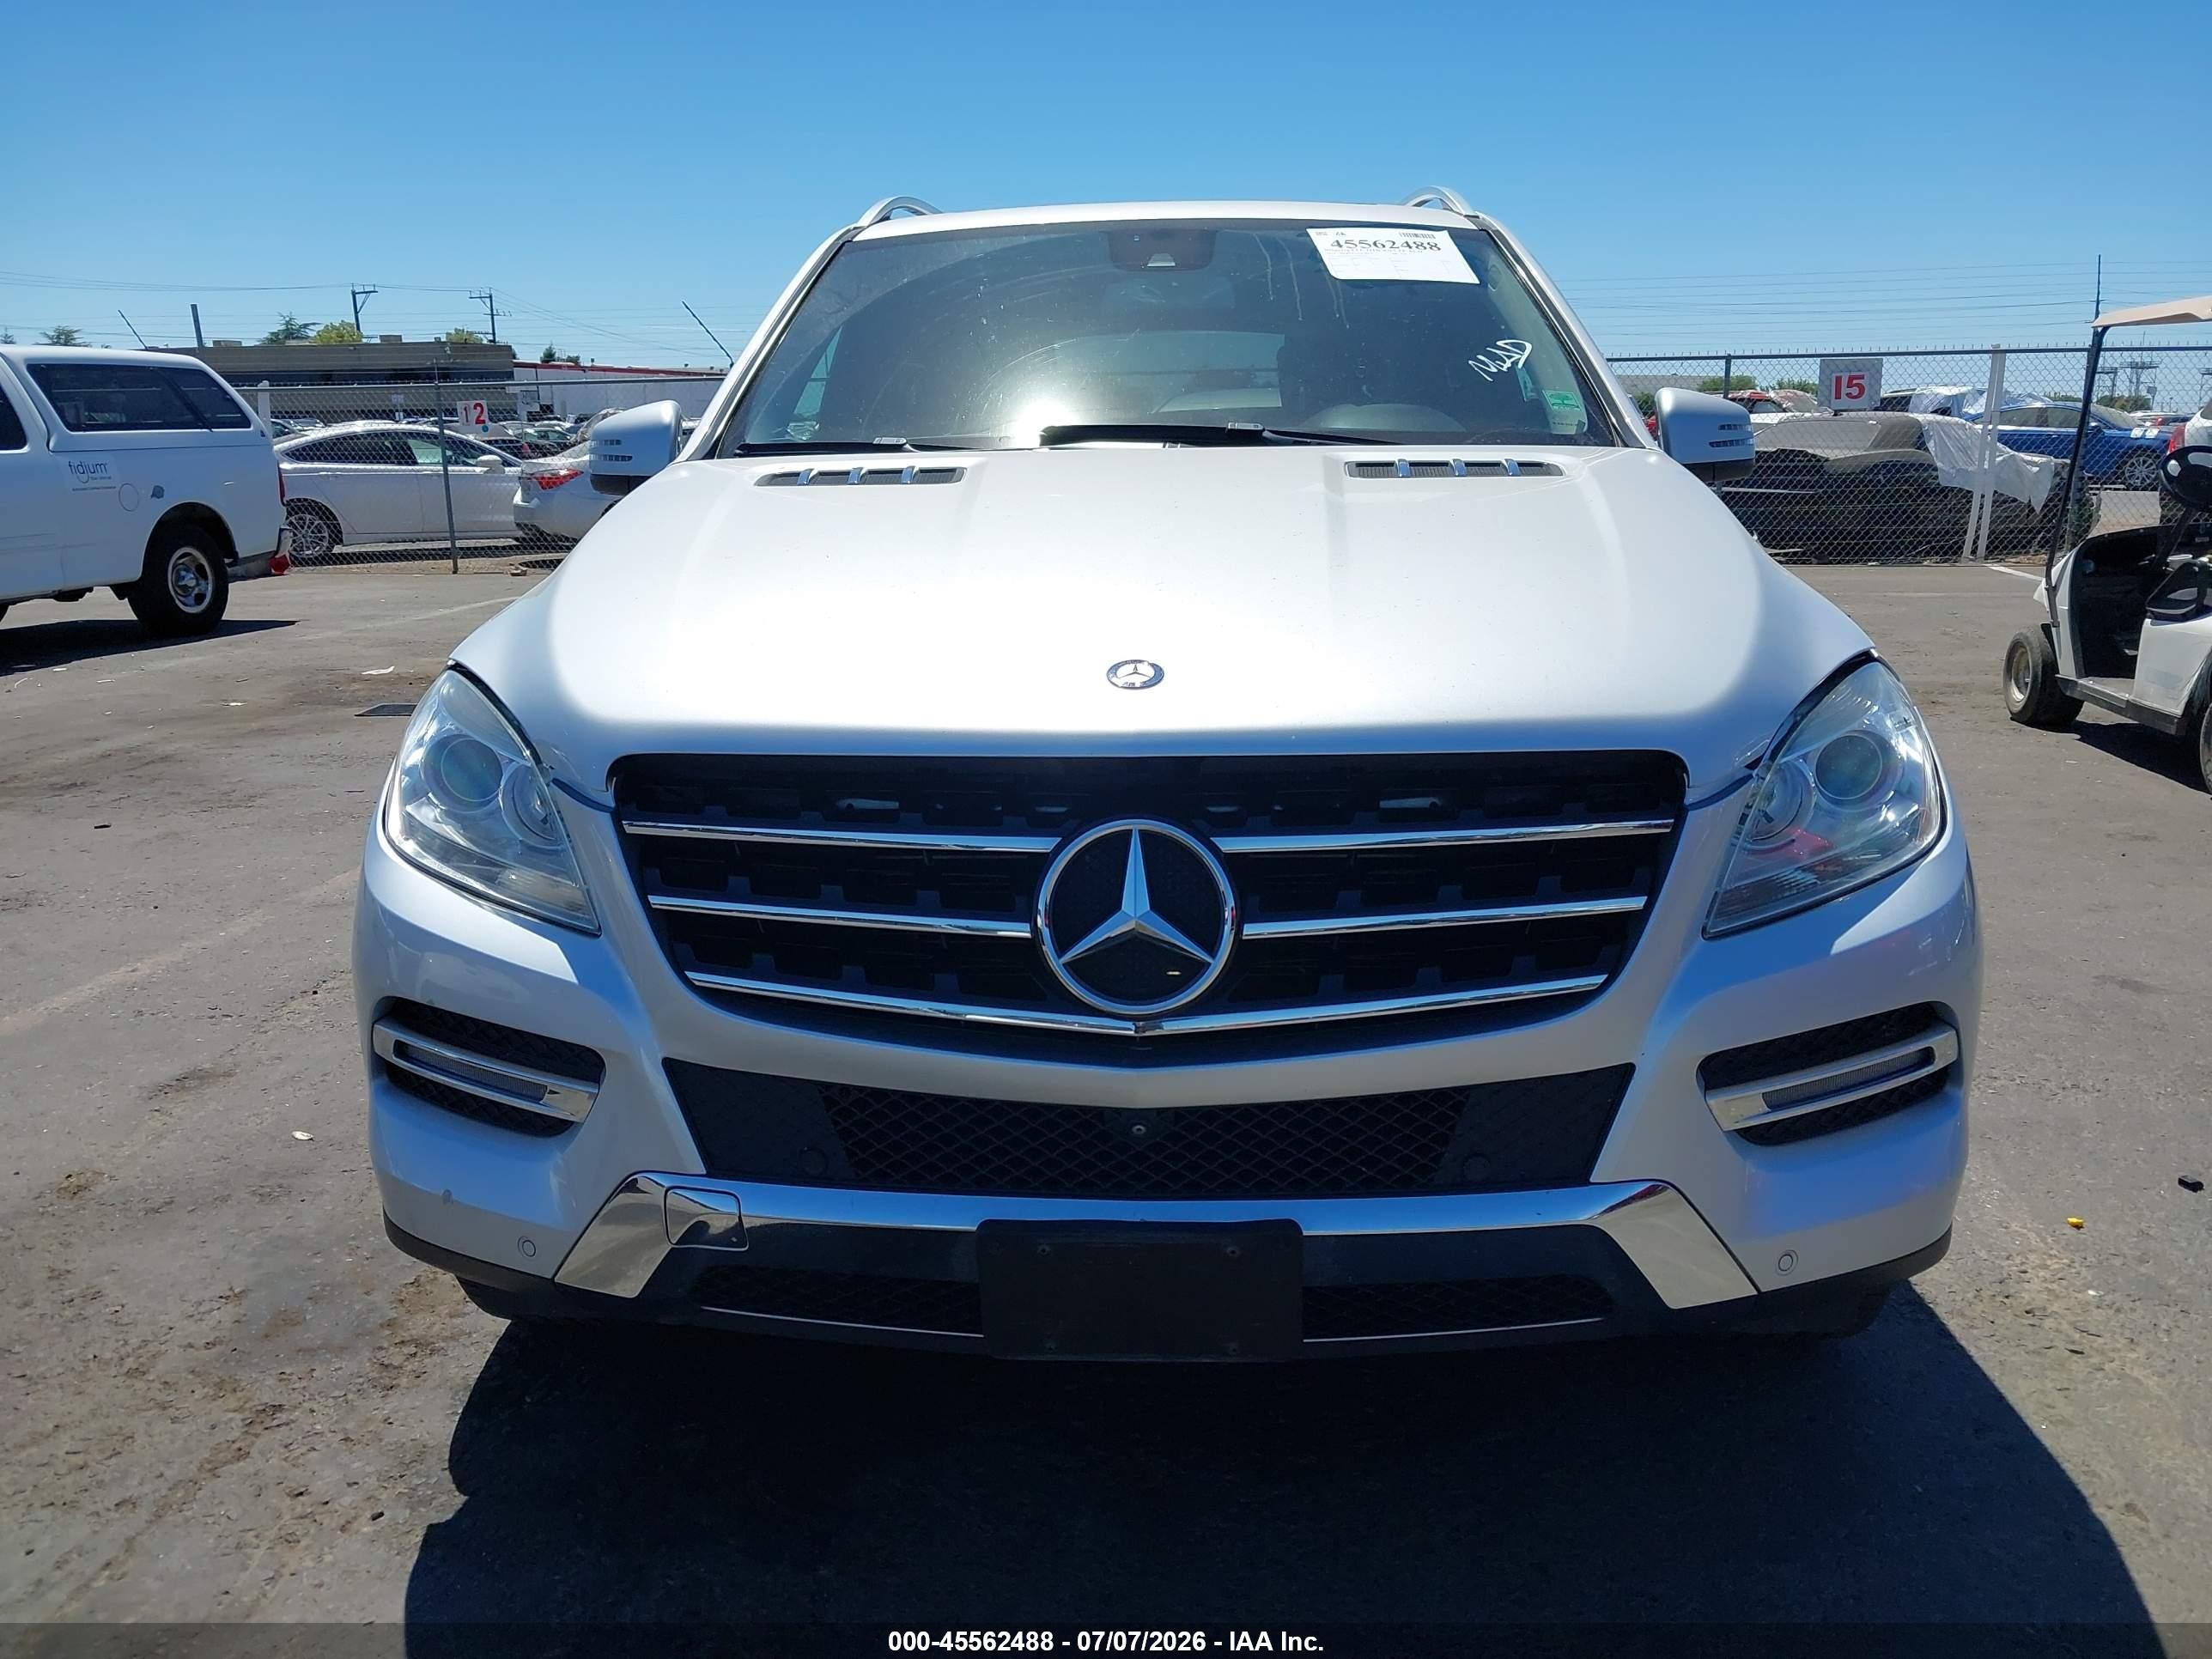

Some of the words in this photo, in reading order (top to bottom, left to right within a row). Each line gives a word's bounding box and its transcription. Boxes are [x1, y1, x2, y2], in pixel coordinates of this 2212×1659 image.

[1330, 239, 1442, 252] 45562488
[1834, 374, 1865, 399] 15
[464, 402, 486, 424] 12
[68, 460, 108, 483] fidium
